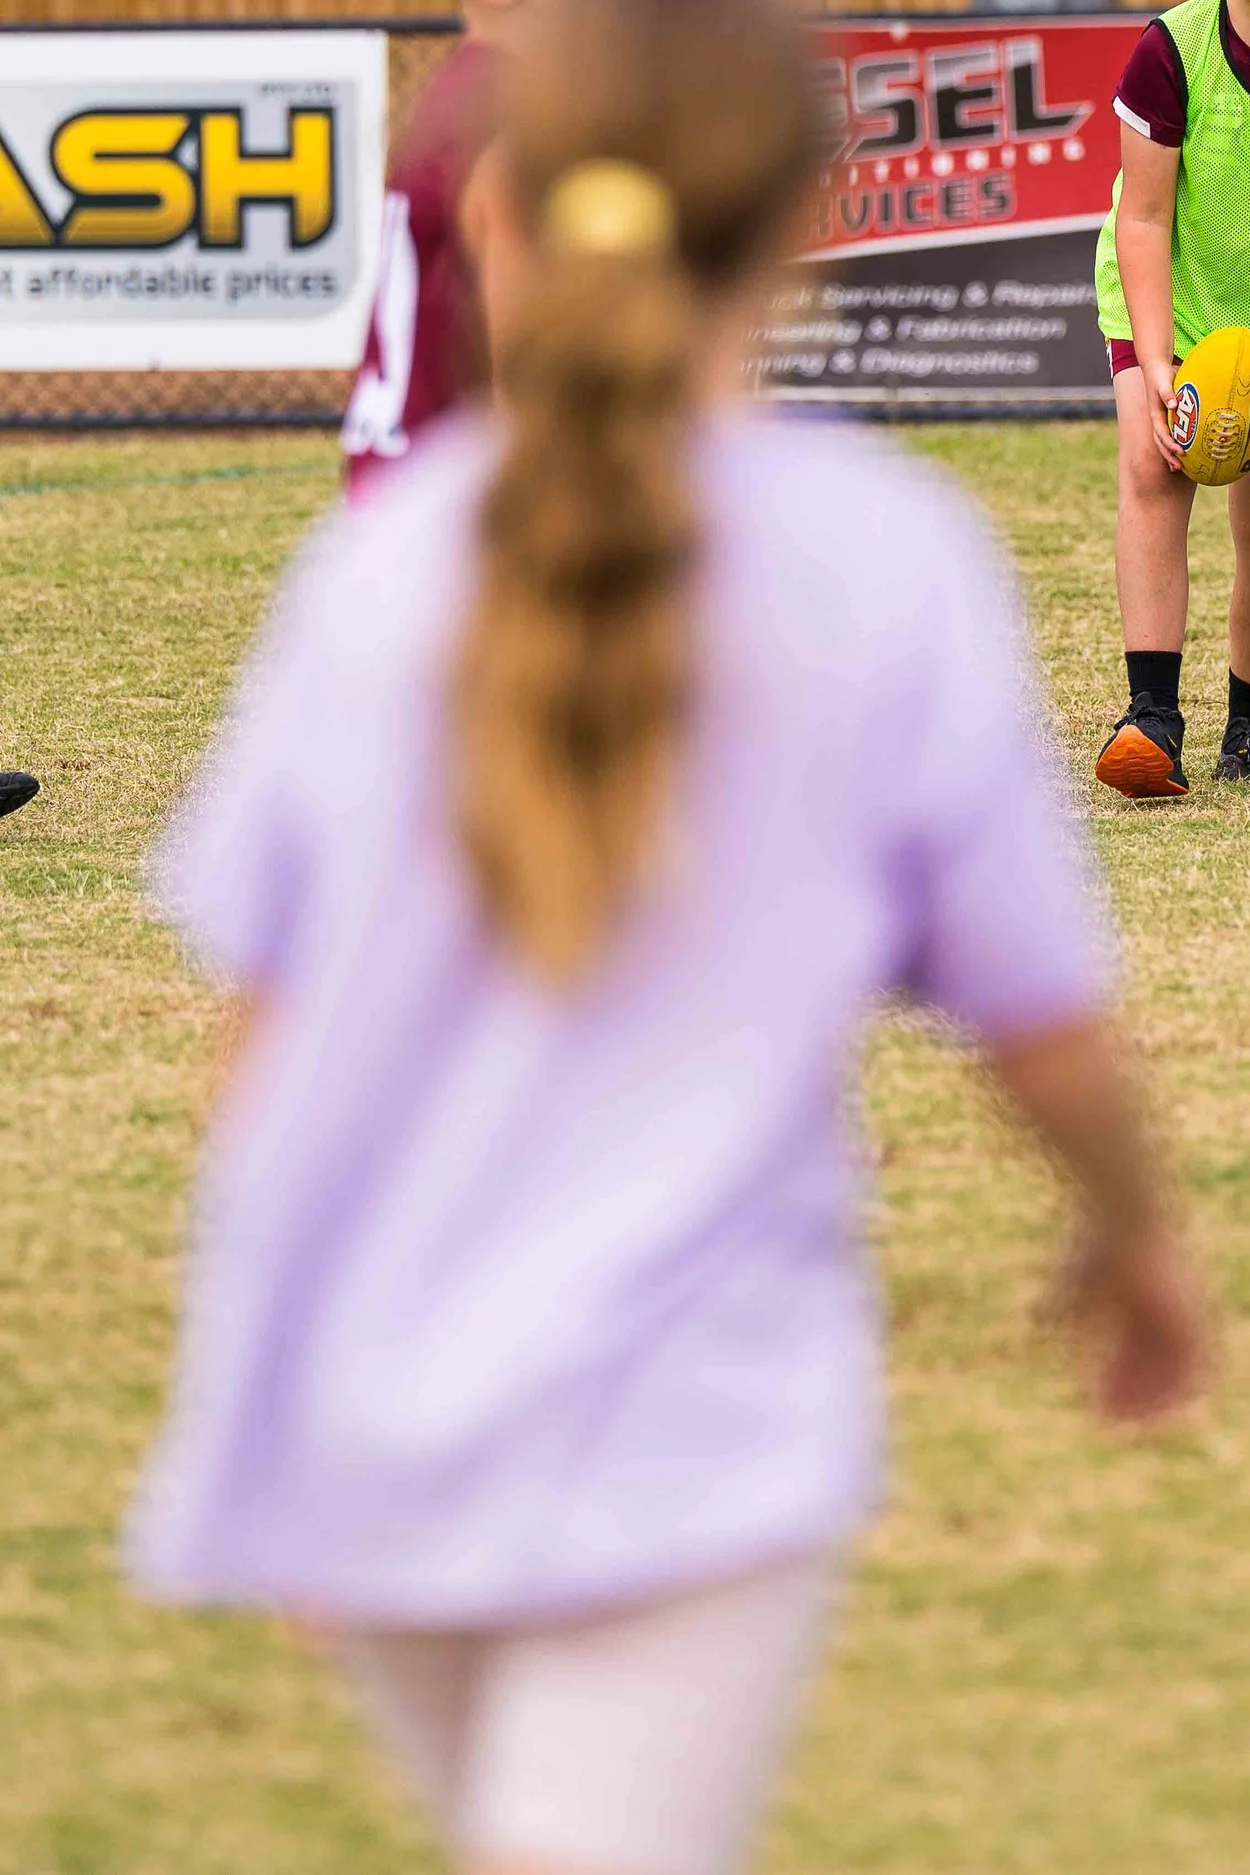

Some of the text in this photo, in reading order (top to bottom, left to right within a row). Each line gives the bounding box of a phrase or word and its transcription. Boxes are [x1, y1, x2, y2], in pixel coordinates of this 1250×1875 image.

[26, 264, 216, 299] affordable
[226, 264, 340, 306] prices
[1174, 385, 1195, 443] AFL
